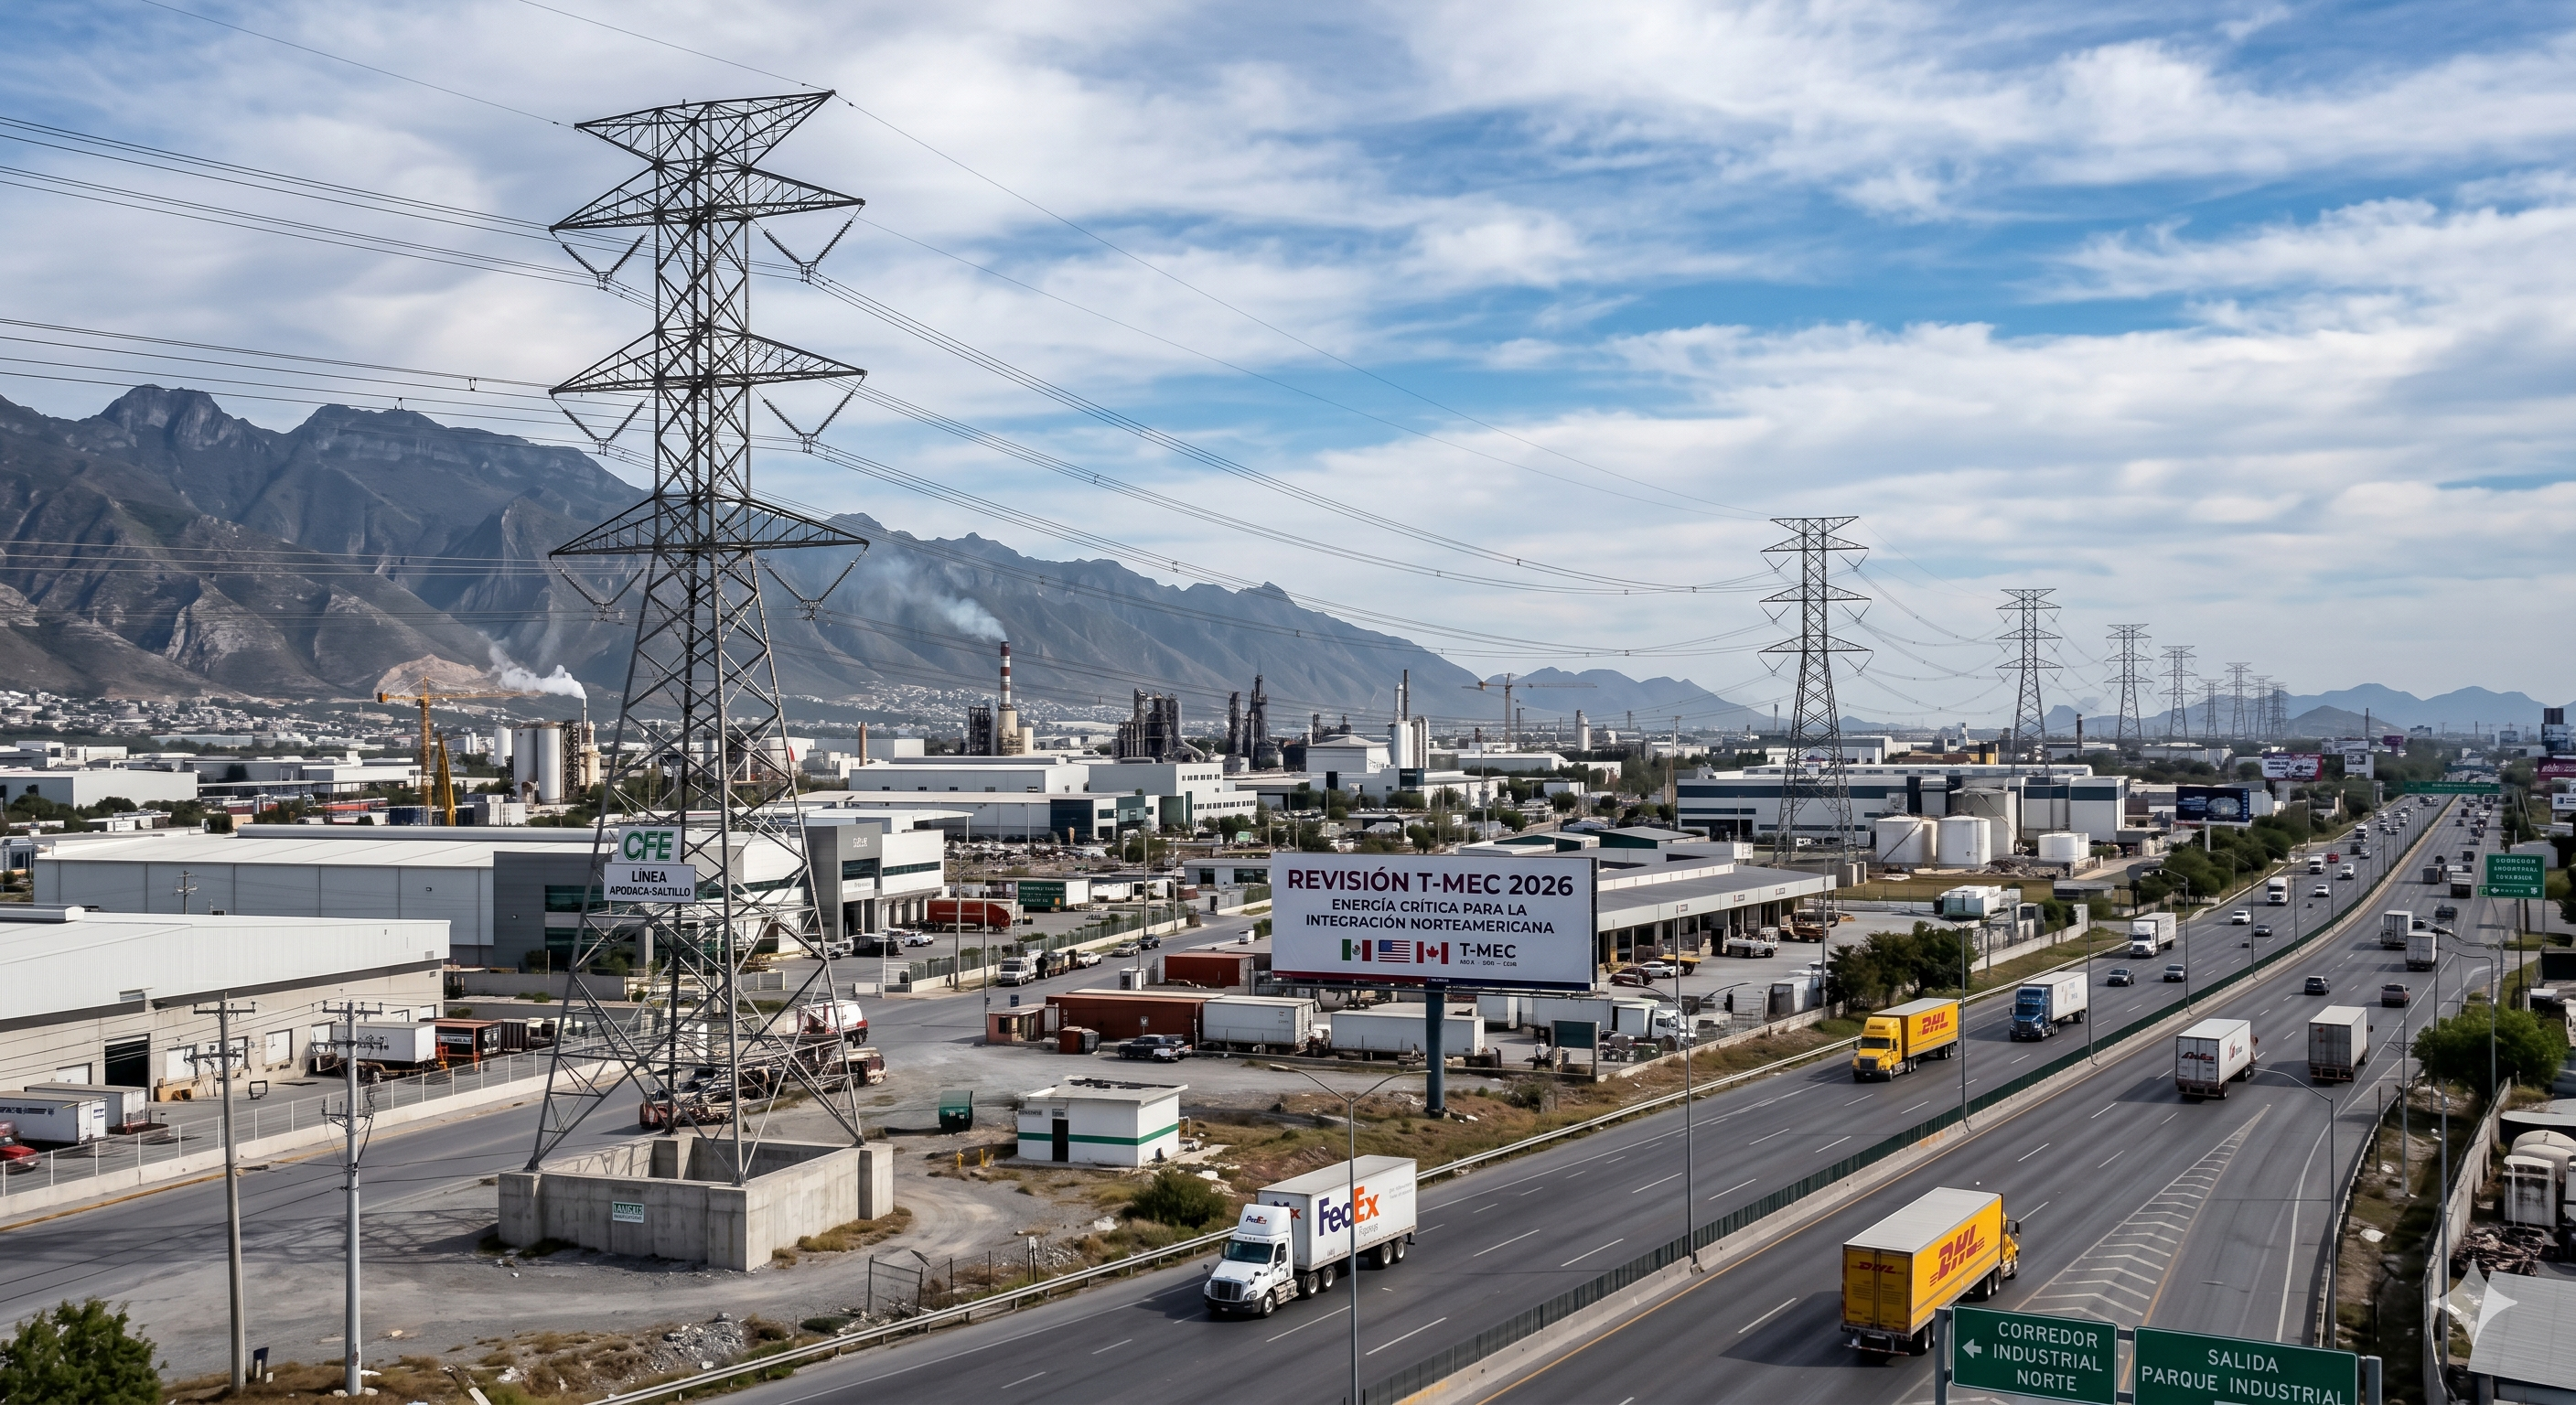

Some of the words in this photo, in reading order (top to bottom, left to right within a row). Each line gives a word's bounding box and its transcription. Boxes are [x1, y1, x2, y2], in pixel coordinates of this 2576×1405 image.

[624, 831, 674, 861] CFE
[632, 868, 667, 883] LÍNEA
[1288, 867, 1410, 892] REVISIÓN
[1417, 872, 1501, 895] T-MEC
[1508, 874, 1573, 896] 2026
[609, 886, 691, 897] APODACA-SALTILLO
[1332, 897, 1396, 912] ENERGÍA
[1401, 898, 1458, 914] CRÍTICA
[1463, 903, 1503, 916] PARA
[1508, 904, 1527, 917] LA
[1305, 915, 1405, 930] INTEGRACIÓN
[1411, 919, 1555, 934] NORTEAMERICANA
[1459, 942, 1517, 959] T-MEC
[1921, 1012, 1949, 1035] DHL
[1318, 1185, 1379, 1237] FedEx
[1937, 1224, 1978, 1282] DHL
[1858, 1261, 1896, 1274] DHL
[1998, 1322, 2098, 1349] CORREDOR
[1993, 1344, 2103, 1372] INDUSTRIAL
[2207, 1349, 2279, 1373] SALIDA
[2016, 1370, 2077, 1392] NORTE
[2141, 1367, 2218, 1392] PARQUE
[2229, 1377, 2346, 1405] INDUSTRIAL
